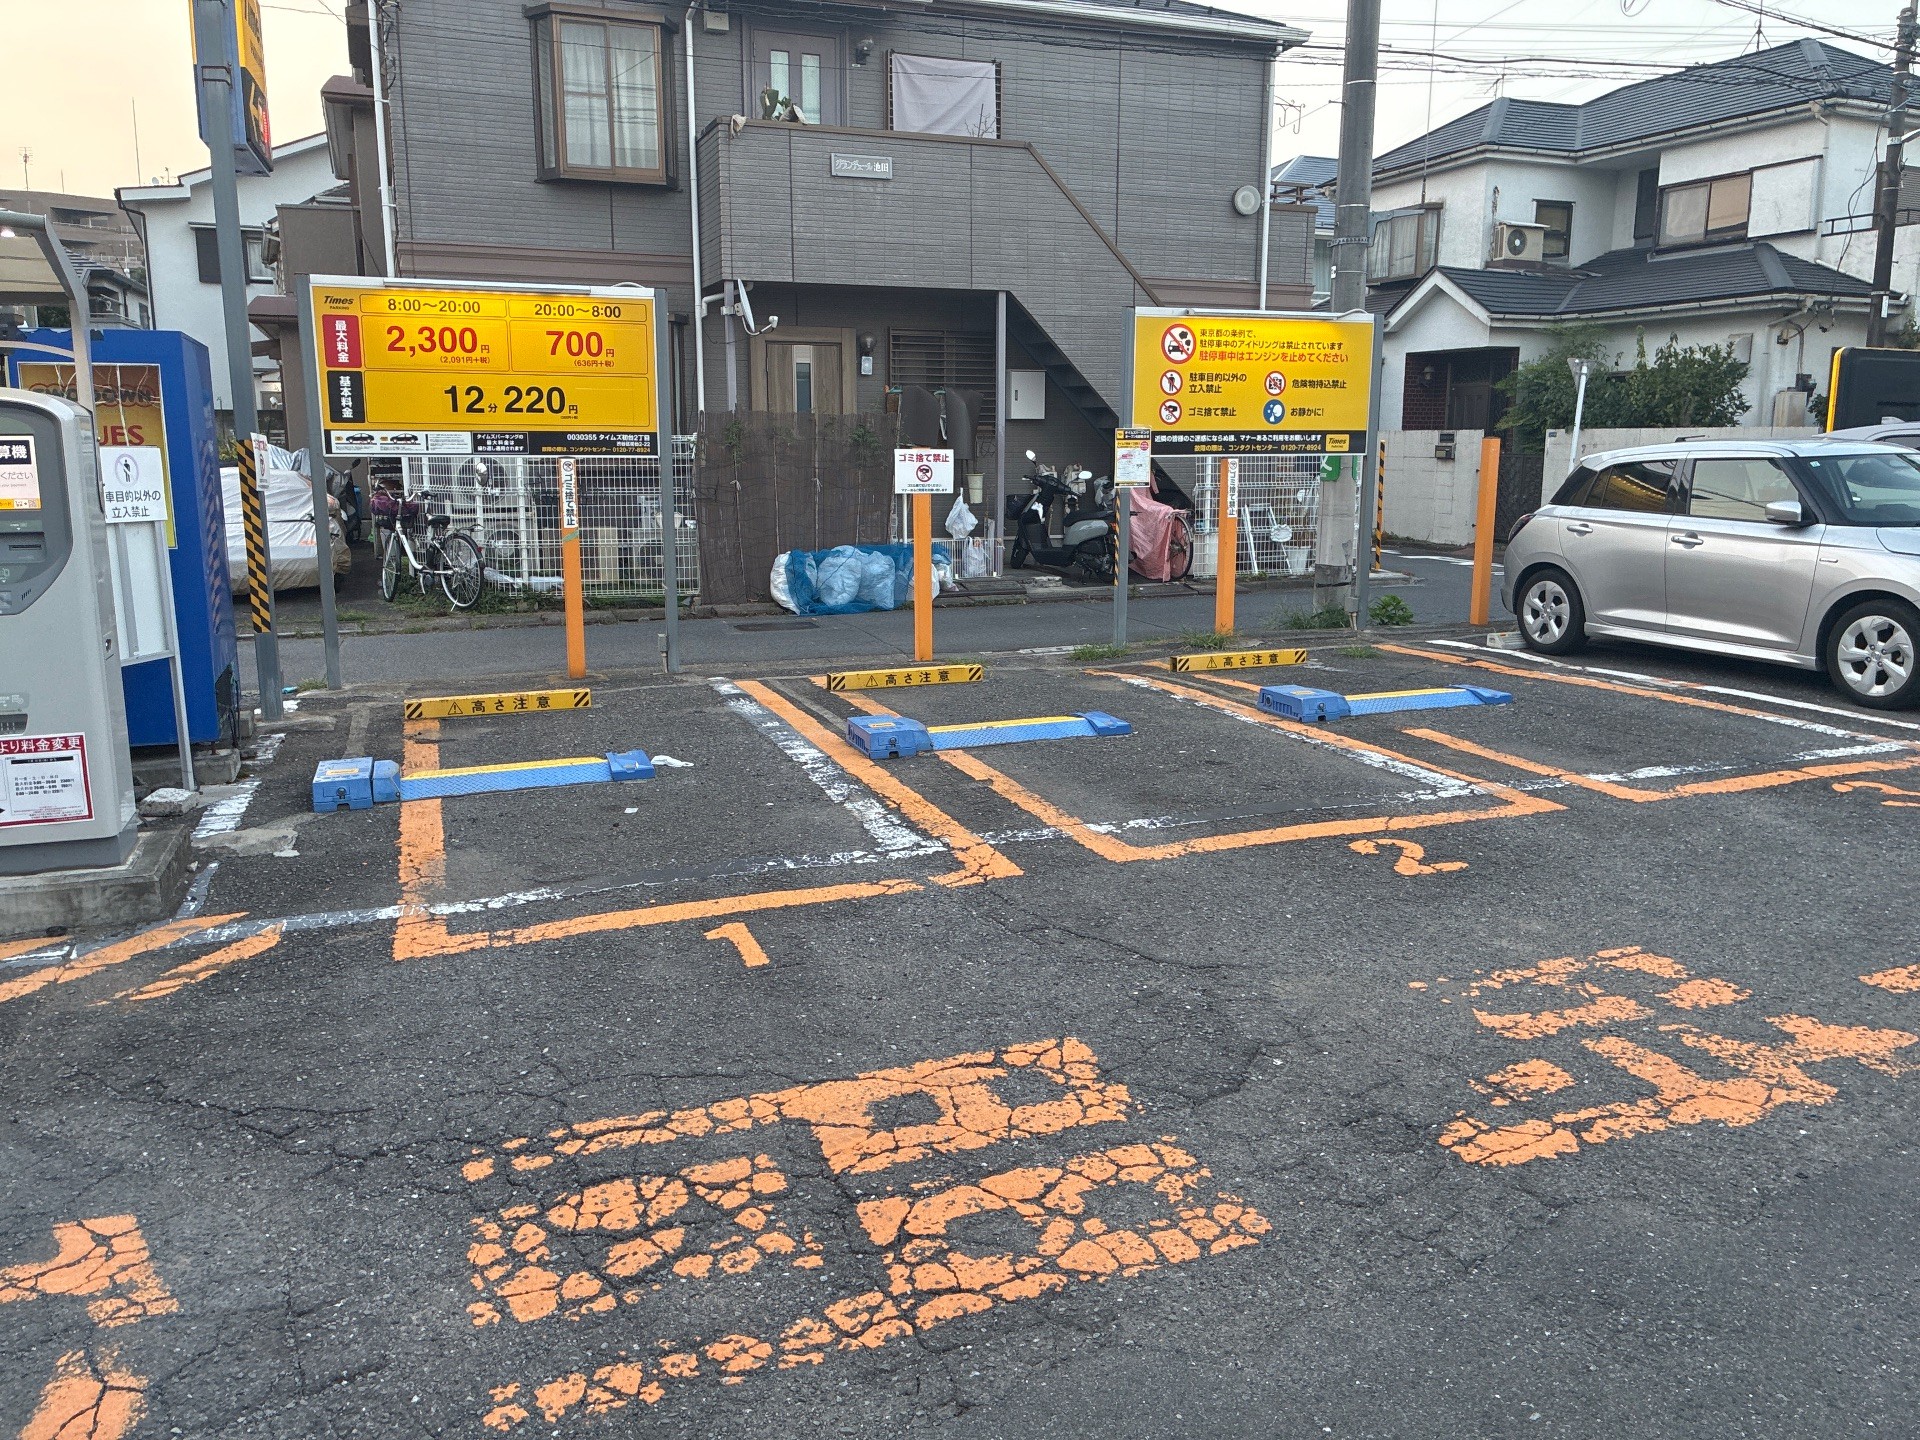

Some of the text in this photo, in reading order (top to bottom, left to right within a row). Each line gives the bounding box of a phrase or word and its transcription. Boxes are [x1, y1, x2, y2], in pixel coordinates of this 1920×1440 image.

[324, 296, 354, 305] Times
[1199, 328, 1257, 339] 東京都の条例で、
[335, 320, 350, 363] 最大料金
[545, 330, 615, 358] 700円
[1198, 350, 1350, 363] 駐停車中はエンジンを止めてください
[1188, 372, 1248, 383] 駐車目的以外の
[1291, 379, 1348, 389] 危険物持込禁止
[1188, 383, 1223, 394] 立入禁止
[339, 375, 354, 418] 基本料金
[1188, 406, 1238, 417] ゴミ捨て禁止
[1328, 437, 1347, 445] Times
[899, 454, 949, 462] ゴミ捨て禁止
[111, 506, 150, 519] 立入禁止
[1223, 653, 1279, 668] 高さ注意
[885, 670, 950, 686] 高さ注意
[472, 695, 551, 713] 高さ注意
[1348, 838, 1469, 876] 2
[703, 922, 770, 968] 1
